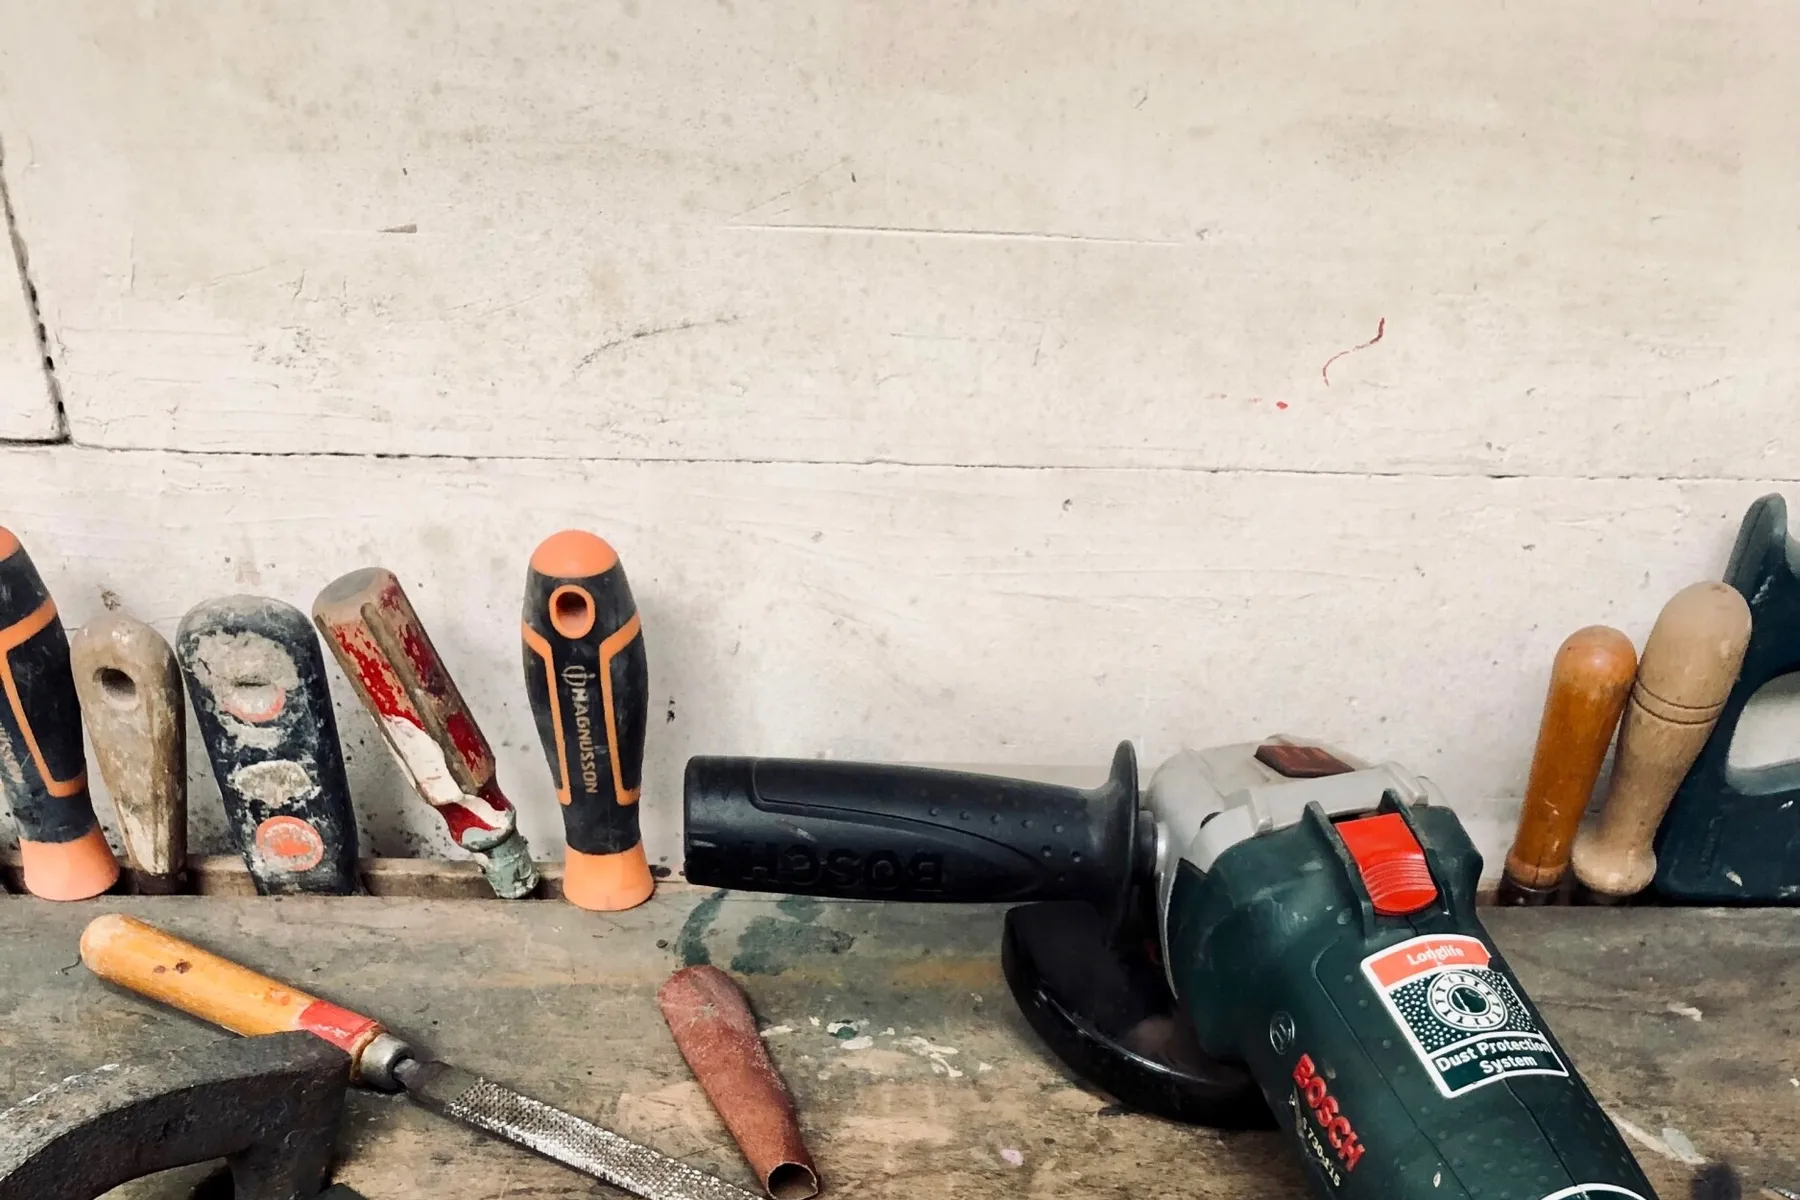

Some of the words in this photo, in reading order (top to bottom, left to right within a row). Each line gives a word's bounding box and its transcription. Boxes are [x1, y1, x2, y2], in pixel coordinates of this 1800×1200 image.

[572, 687, 599, 793] MAGNUSSON
[740, 842, 945, 893] BOSCH
[1406, 944, 1465, 966] Longlife
[1435, 1047, 1480, 1073] Dust
[1476, 1038, 1552, 1056] Protection
[1479, 1054, 1538, 1074] System
[1293, 1053, 1365, 1172] BOSCH
